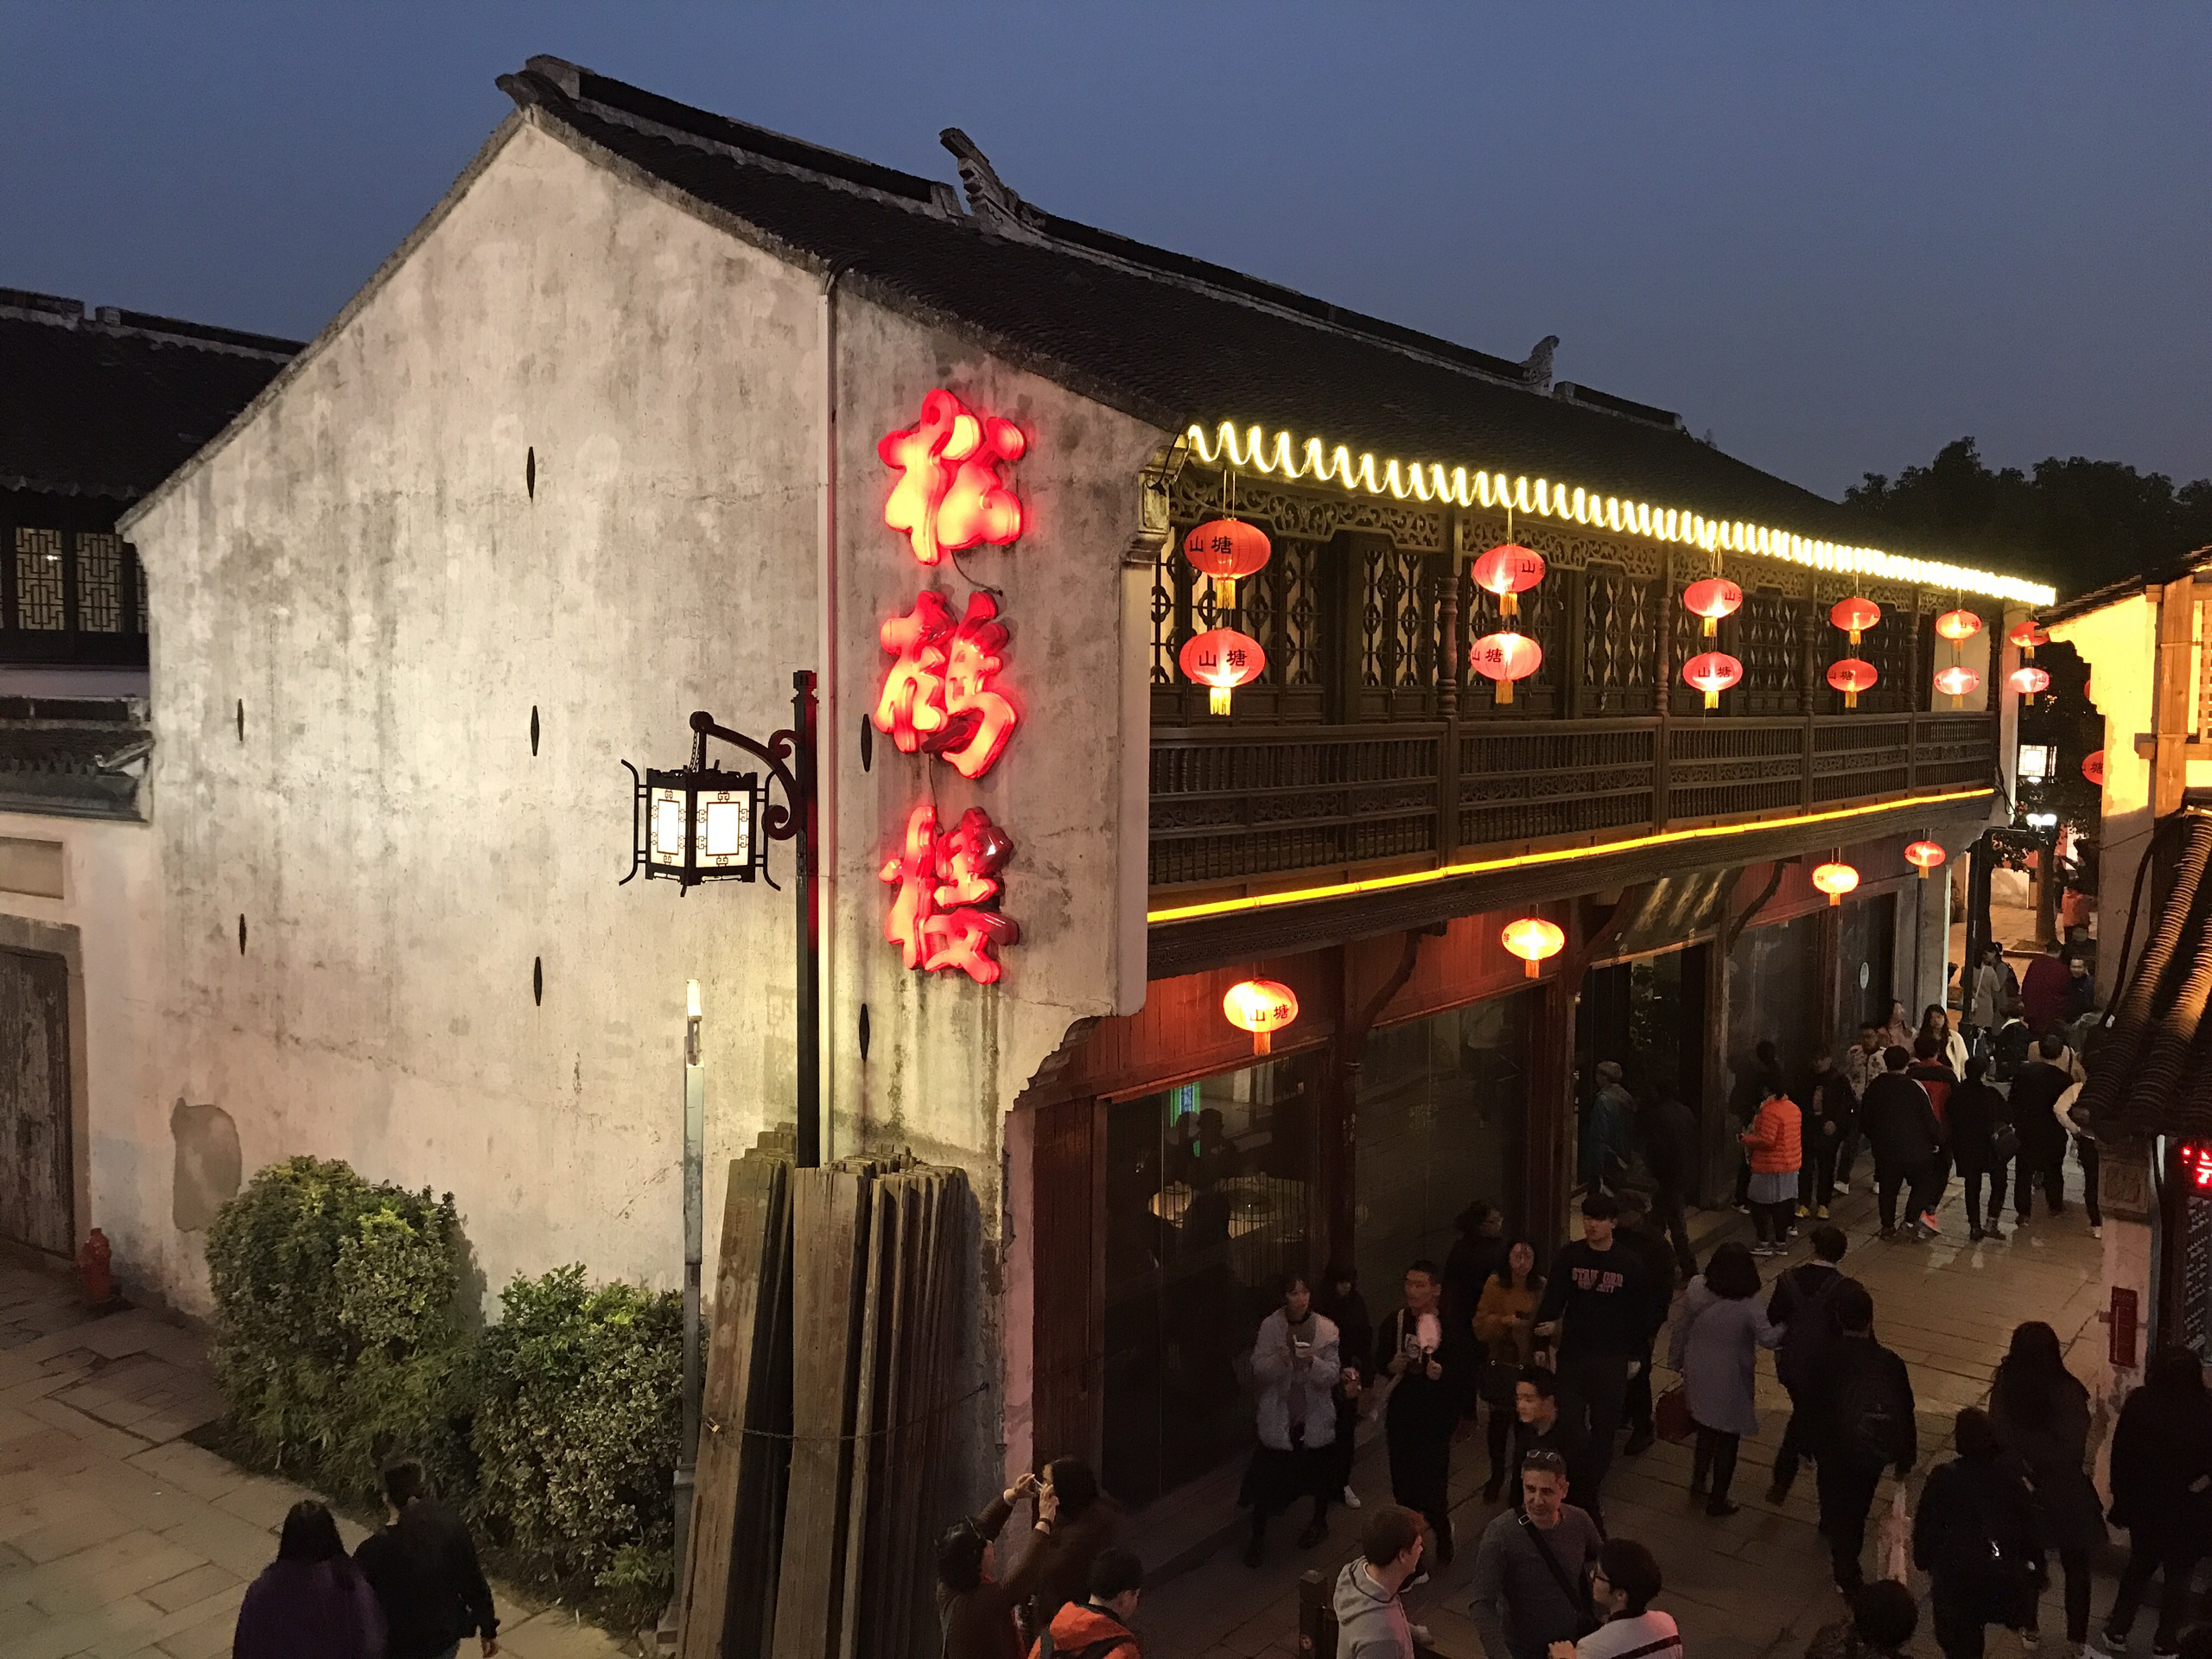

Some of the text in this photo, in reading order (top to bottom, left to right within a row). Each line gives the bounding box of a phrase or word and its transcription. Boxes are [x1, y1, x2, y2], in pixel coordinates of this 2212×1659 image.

[1189, 535, 1233, 555] 山塘
[1198, 649, 1247, 667] 山塘
[1471, 648, 1504, 663] 山塘
[1699, 666, 1732, 678] 山塘
[1250, 1003, 1288, 1022] 山塘
